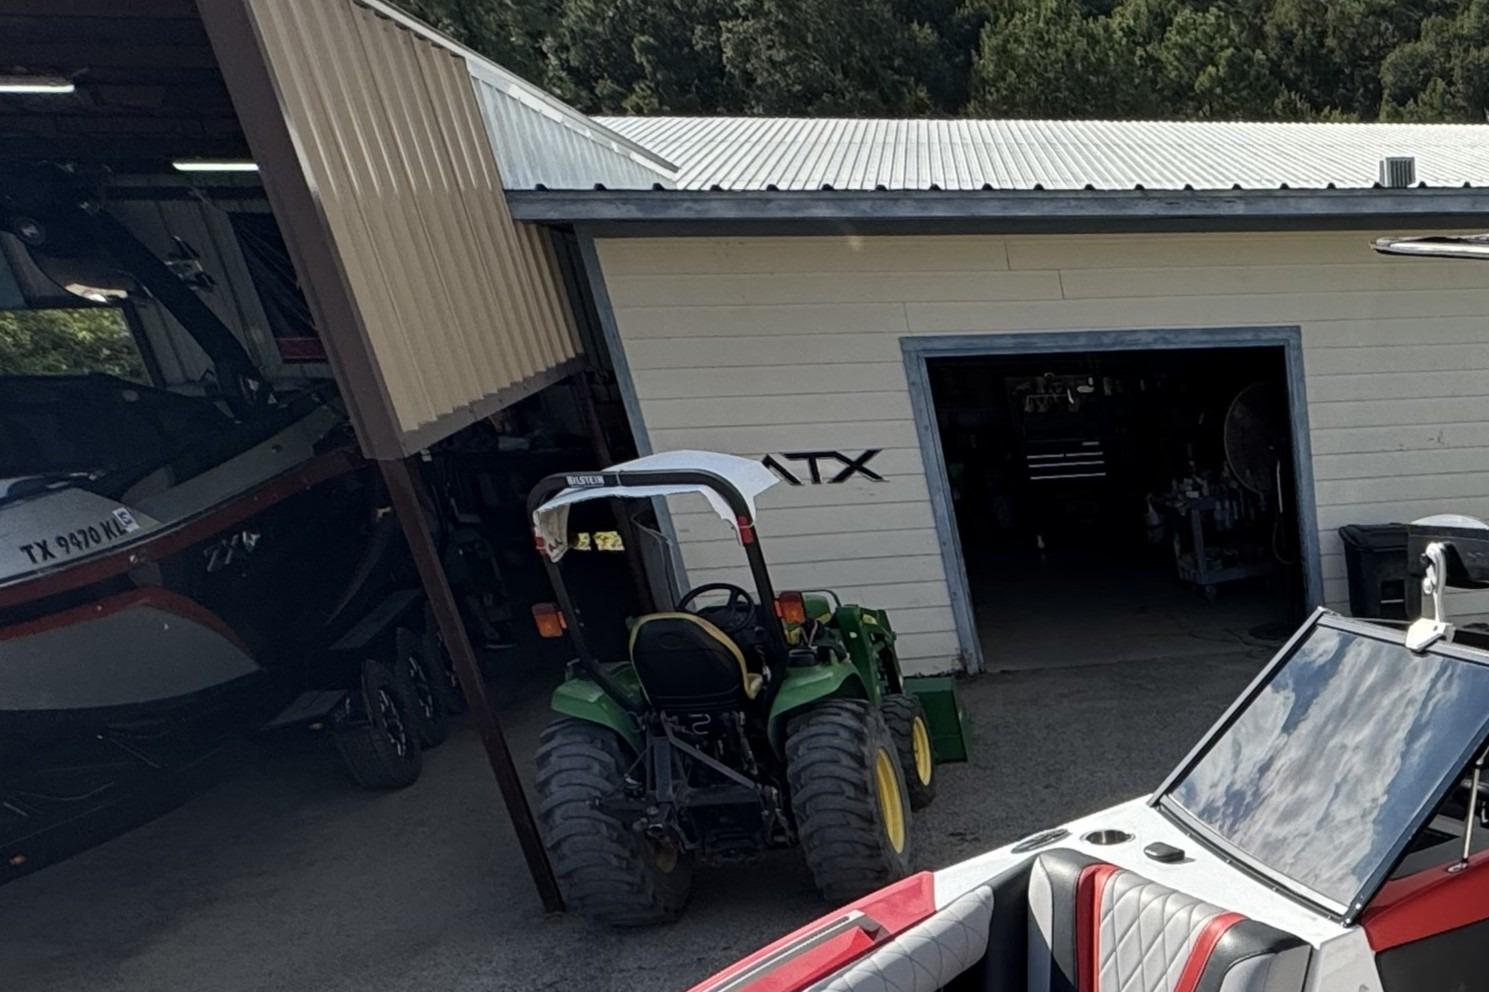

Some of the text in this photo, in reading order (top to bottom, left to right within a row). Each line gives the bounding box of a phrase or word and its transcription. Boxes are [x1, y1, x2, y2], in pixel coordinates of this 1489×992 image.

[566, 475, 605, 486] BILSTEIN
[19, 538, 56, 564] TX
[57, 525, 102, 554] 9470
